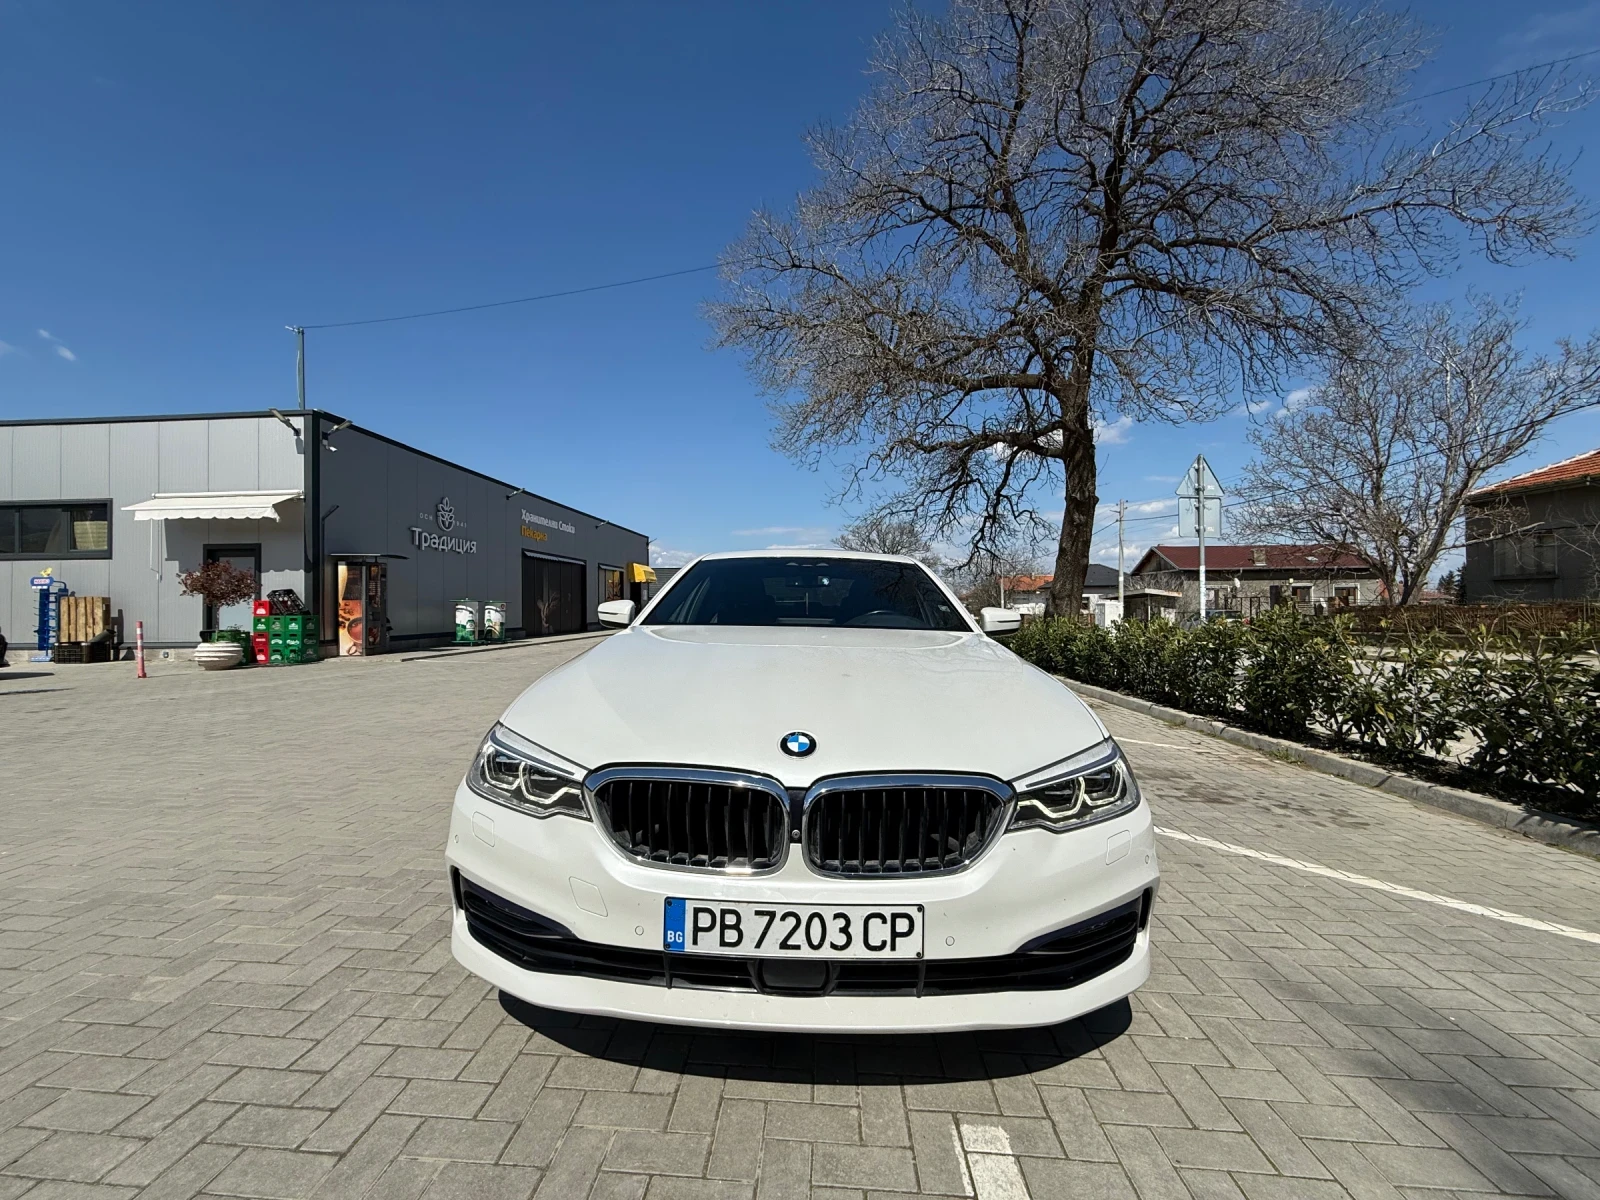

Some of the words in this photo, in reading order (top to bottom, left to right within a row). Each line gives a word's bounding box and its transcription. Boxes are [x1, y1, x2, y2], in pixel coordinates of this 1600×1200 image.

[409, 526, 477, 555] Традиция
[521, 525, 548, 542] Пекарна
[667, 930, 683, 943] BG
[692, 906, 744, 948] PB
[753, 909, 853, 951] 7203
[863, 912, 915, 952] CP
